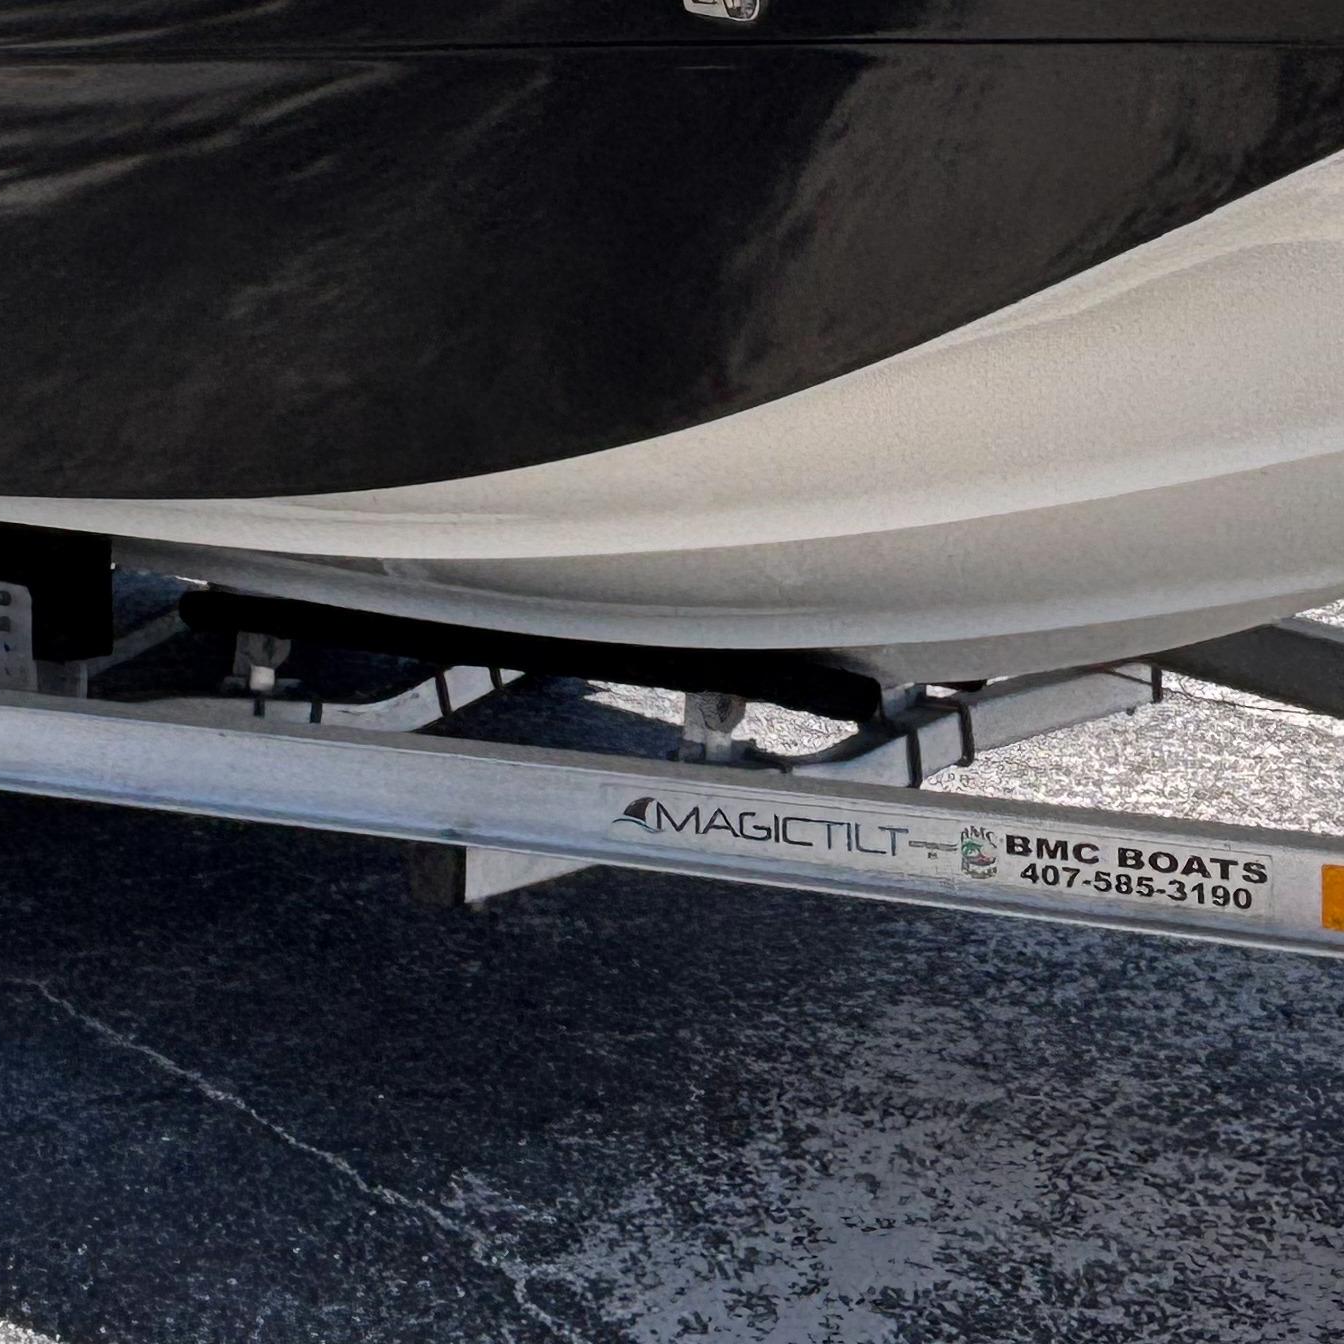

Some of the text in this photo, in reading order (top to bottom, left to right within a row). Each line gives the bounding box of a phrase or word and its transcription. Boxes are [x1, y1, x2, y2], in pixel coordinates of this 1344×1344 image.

[656, 801, 909, 856] MAGICTILT
[1006, 834, 1268, 884] BMC BOATS
[1020, 863, 1253, 910] 407-585-3190
